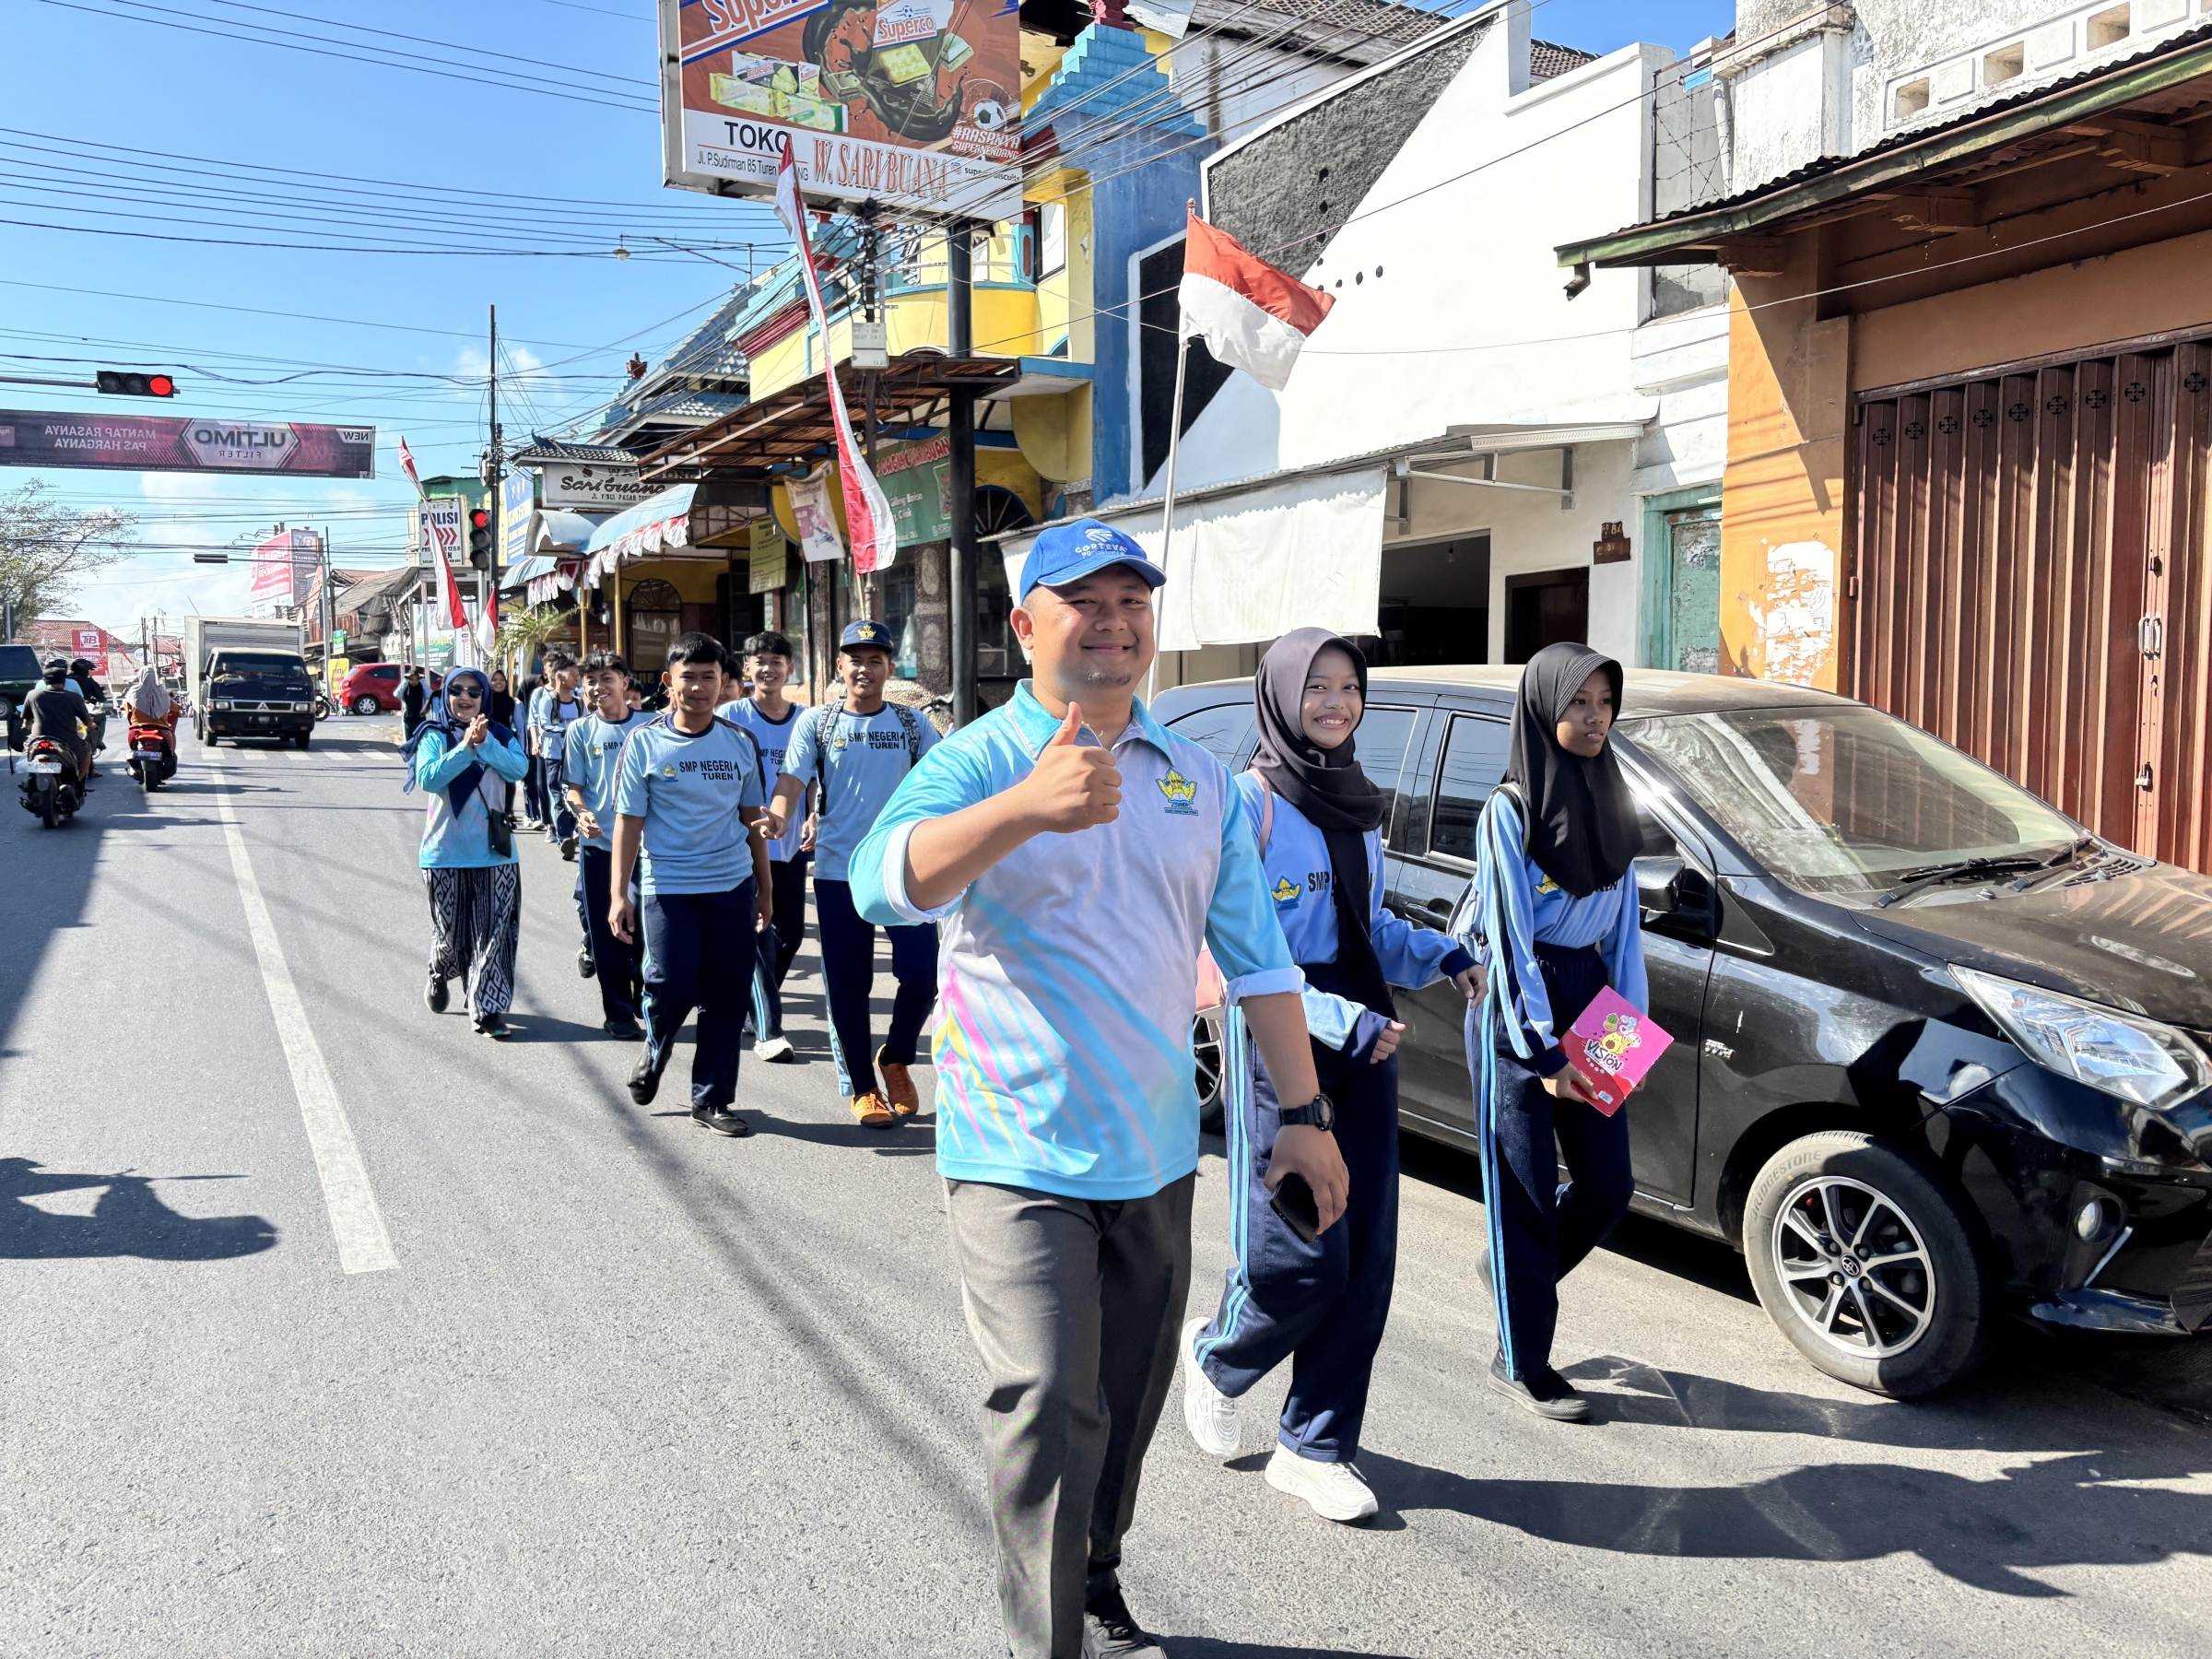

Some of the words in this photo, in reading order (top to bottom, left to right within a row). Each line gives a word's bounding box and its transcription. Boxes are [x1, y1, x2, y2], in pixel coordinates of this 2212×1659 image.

[877, 16, 936, 41] Superco
[698, 150, 706, 165] Jl.
[747, 159, 756, 172] 85
[758, 160, 777, 176] Turen
[813, 138, 833, 183] W.
[838, 142, 880, 190] SARI
[885, 152, 947, 202] BUANA
[560, 476, 604, 492] Sari
[603, 741, 618, 750] SMP
[849, 732, 866, 743] SMP
[867, 731, 900, 742] NEGERI
[900, 731, 906, 750] 1
[868, 741, 900, 749] TUREN
[679, 760, 698, 773] SMP
[700, 759, 733, 772] NEGERI
[771, 758, 783, 766] TUR
[701, 772, 734, 781] TUREN
[1307, 871, 1331, 893] SMP
